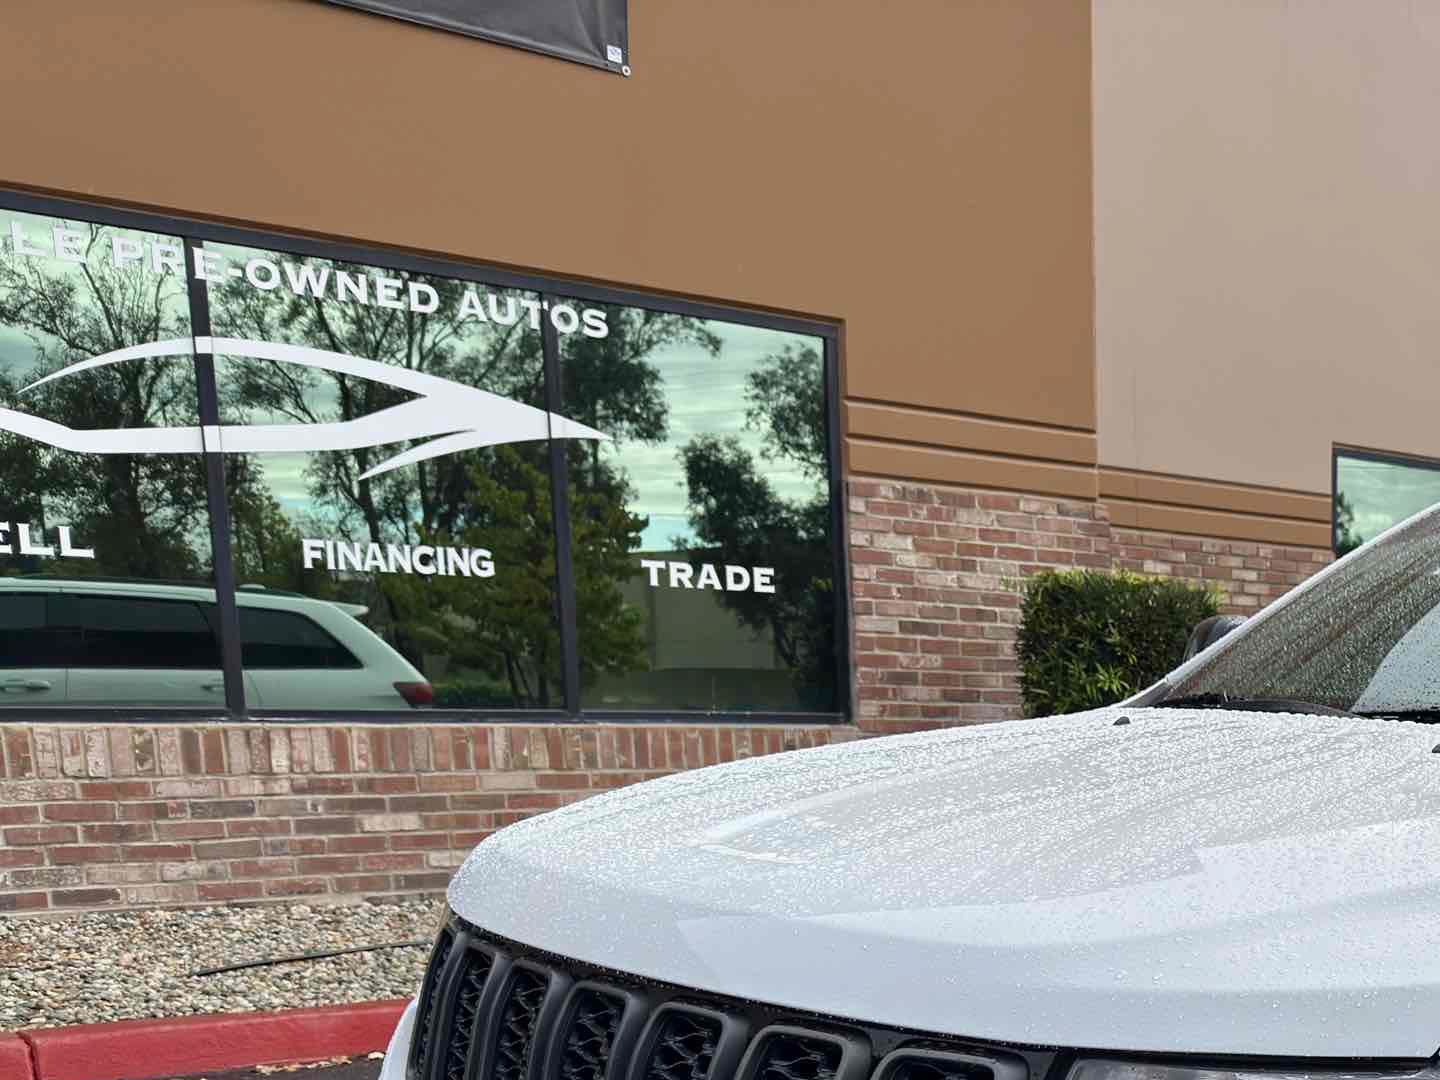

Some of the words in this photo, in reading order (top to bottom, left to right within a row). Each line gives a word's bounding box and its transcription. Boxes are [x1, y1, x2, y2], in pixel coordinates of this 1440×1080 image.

[111, 236, 441, 314] PRE-OWNED
[457, 293, 610, 340] AUTOS
[302, 537, 496, 578] FINANCING
[640, 558, 776, 594] TRADE
